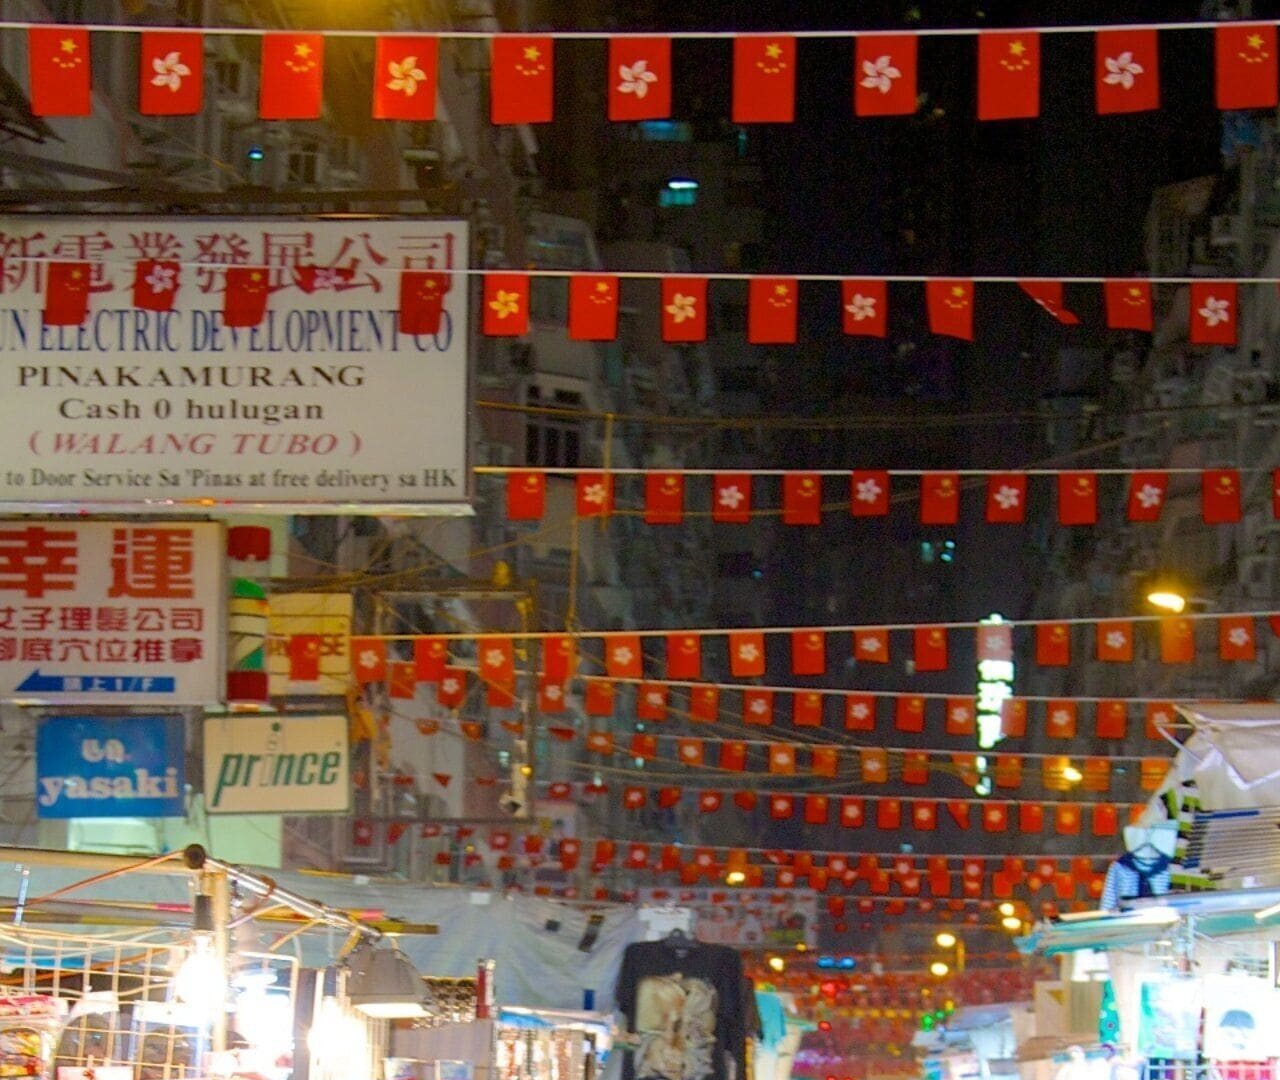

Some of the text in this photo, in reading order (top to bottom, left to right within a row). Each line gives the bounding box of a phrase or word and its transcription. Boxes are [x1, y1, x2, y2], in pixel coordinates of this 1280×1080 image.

[39, 309, 182, 352] ELECTRIC
[191, 310, 400, 352] DEVELOPMENT
[17, 365, 367, 388] PINAKAMURANG
[59, 397, 141, 420] Cash
[185, 398, 324, 425] hulugan
[6, 469, 26, 487] to
[32, 467, 78, 487] Door
[82, 468, 153, 488] Service
[158, 468, 181, 488] Sa
[247, 470, 267, 488] at
[272, 468, 311, 488] free
[315, 468, 390, 492] delivery
[397, 472, 418, 488] sa
[422, 468, 458, 488] HK
[211, 721, 342, 807] prince
[39, 766, 178, 807] yasaki
